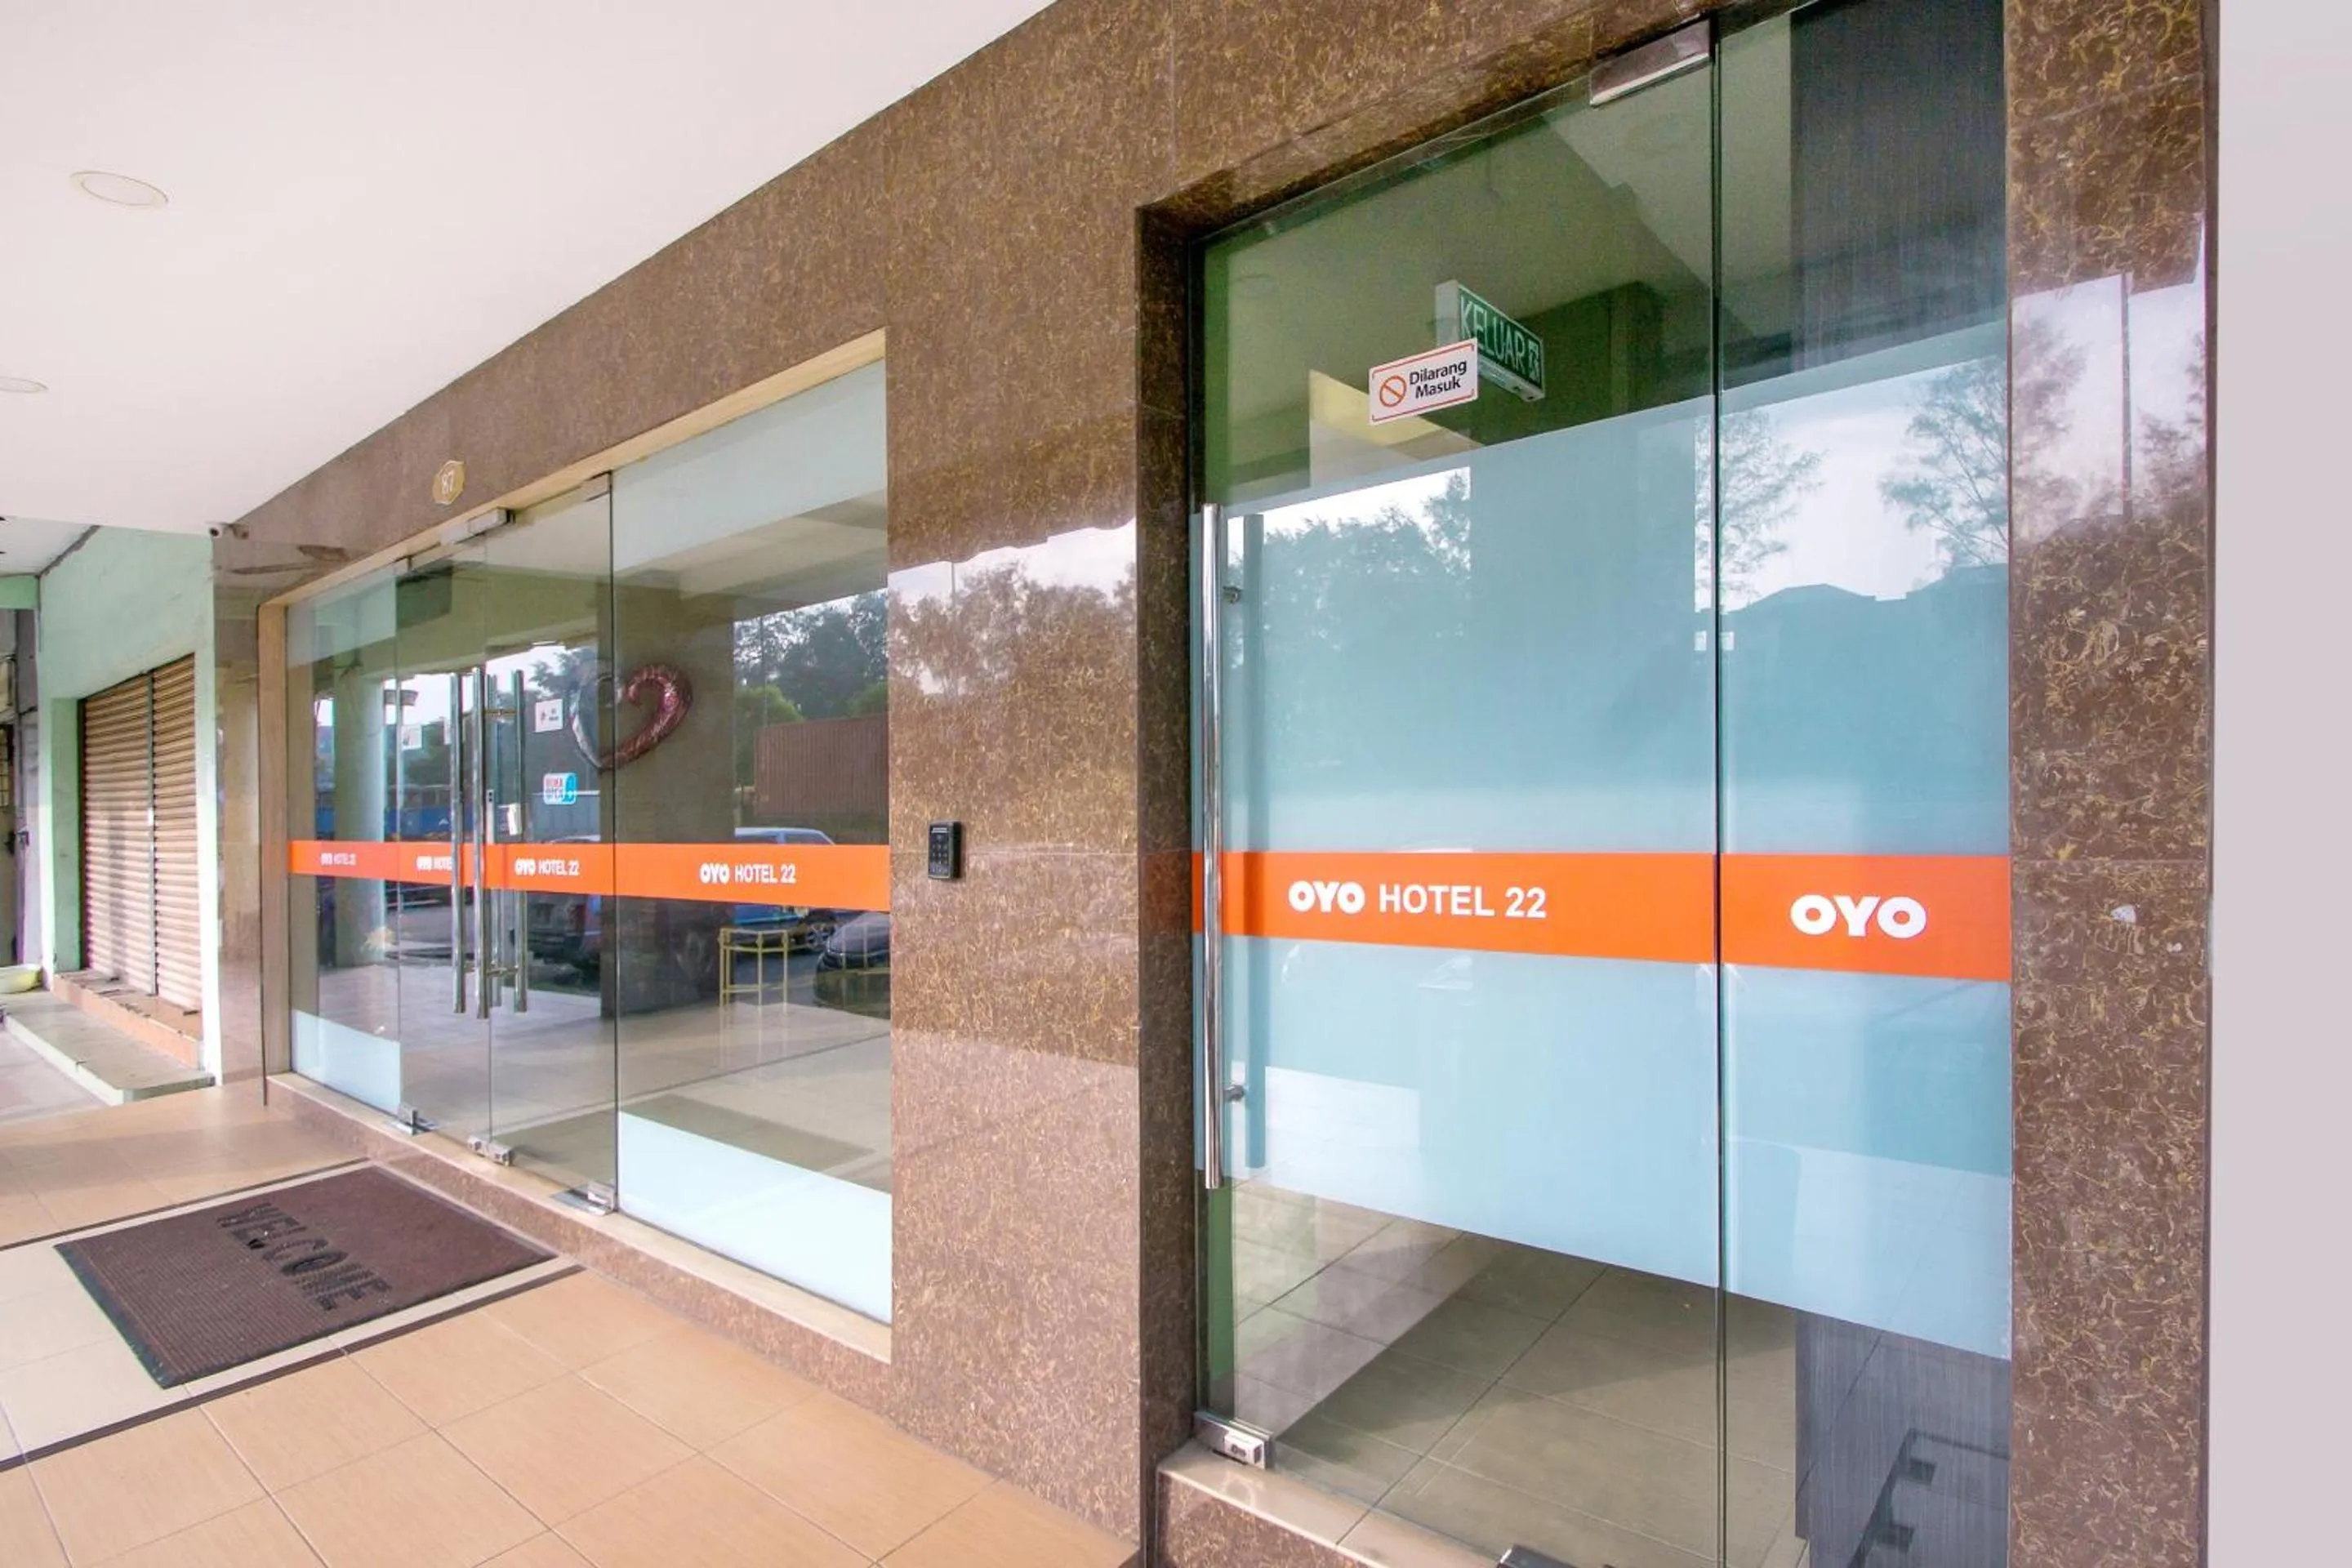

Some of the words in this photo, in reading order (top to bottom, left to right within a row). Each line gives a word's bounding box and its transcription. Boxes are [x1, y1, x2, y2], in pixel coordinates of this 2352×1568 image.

[1460, 296, 1526, 380] KELUAR
[1410, 360, 1468, 385] Dilarang
[1415, 376, 1462, 399] Masuk
[514, 858, 536, 876] OYO
[537, 858, 568, 876] HOTEL
[568, 859, 580, 876] 22
[700, 862, 730, 884] OYO
[734, 863, 777, 884] HOTEL
[780, 864, 796, 884] 22
[1288, 880, 1365, 915] OYO
[1379, 883, 1495, 916] HOTEL
[1504, 886, 1547, 919] 22
[1790, 893, 1927, 939] OYO
